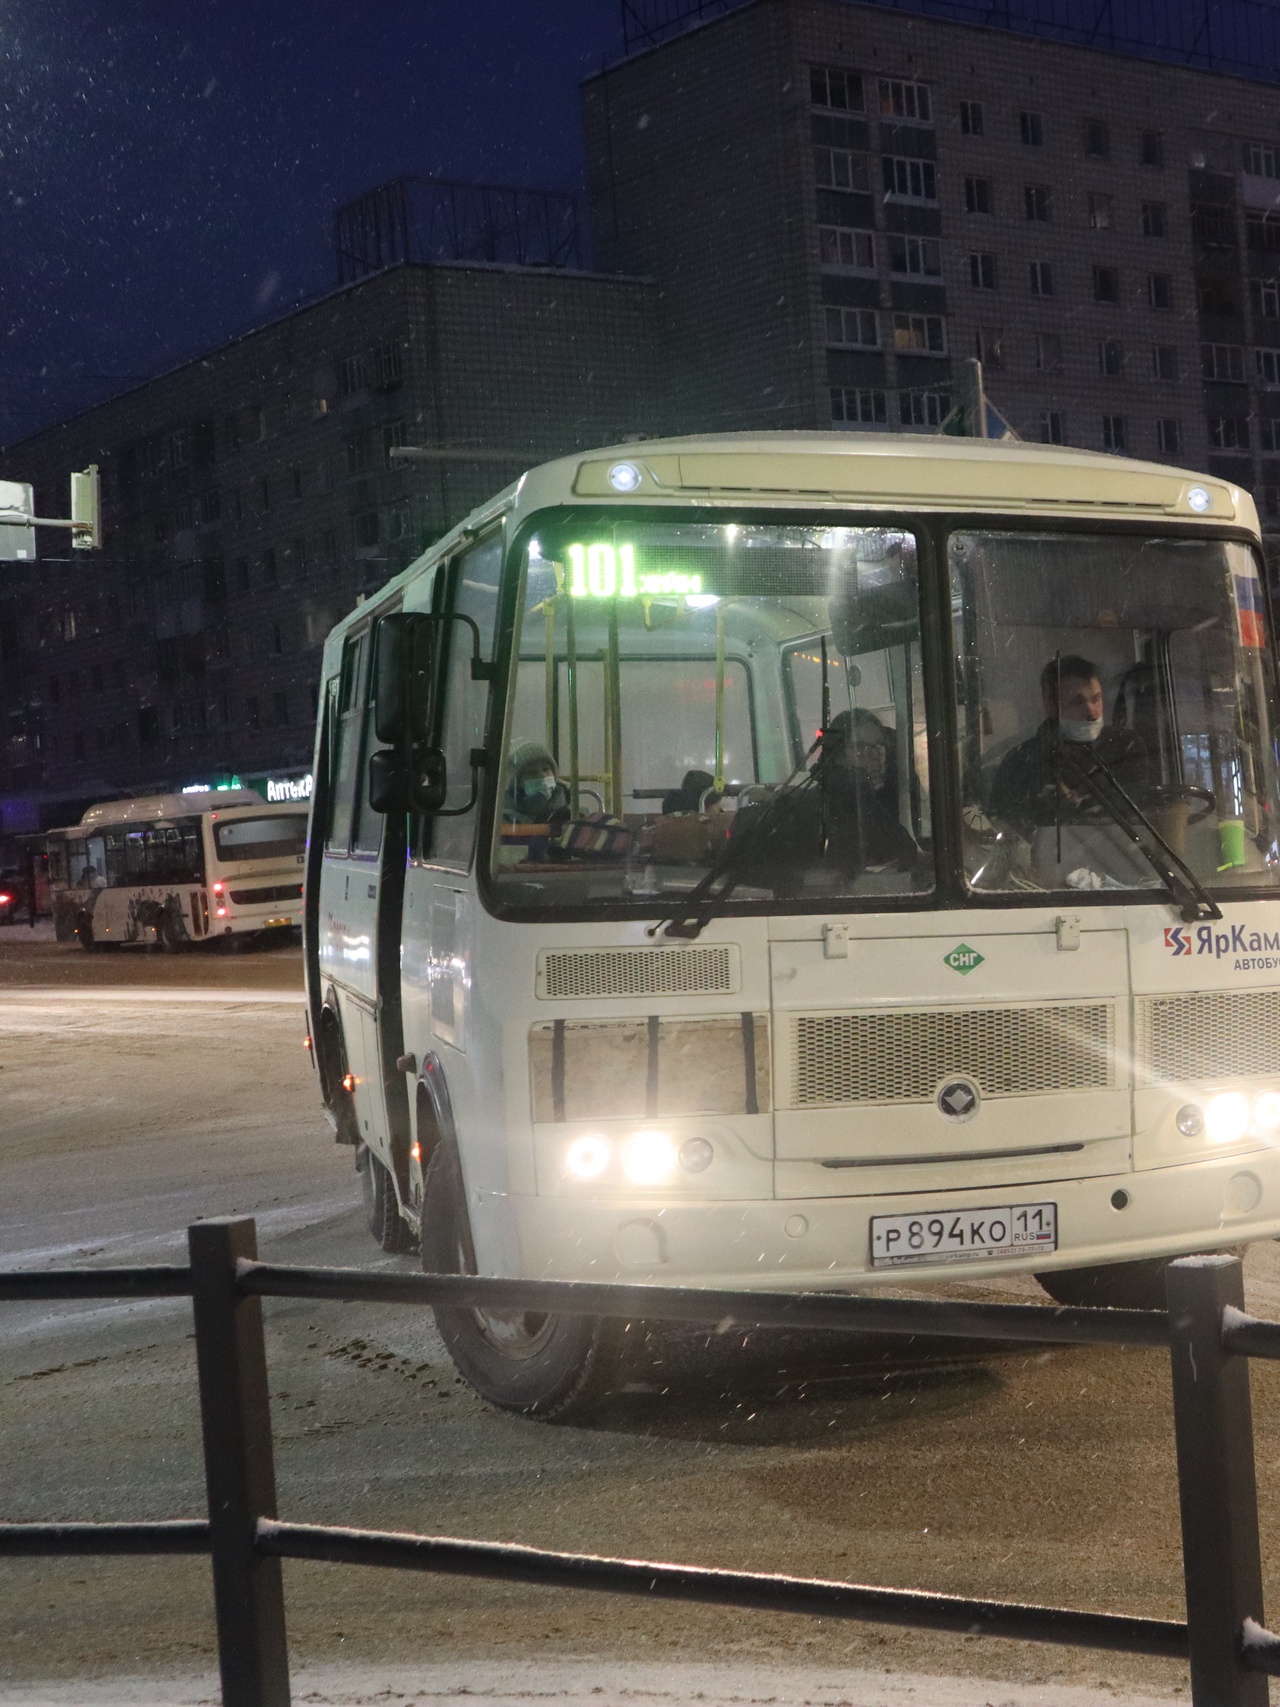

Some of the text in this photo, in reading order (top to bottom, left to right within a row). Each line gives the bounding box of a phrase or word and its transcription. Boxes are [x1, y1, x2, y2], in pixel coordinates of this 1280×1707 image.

[568, 543, 638, 597] 101
[949, 952, 978, 967] СНГ
[1016, 1208, 1044, 1232] 11
[1014, 1231, 1036, 1242] RUS
